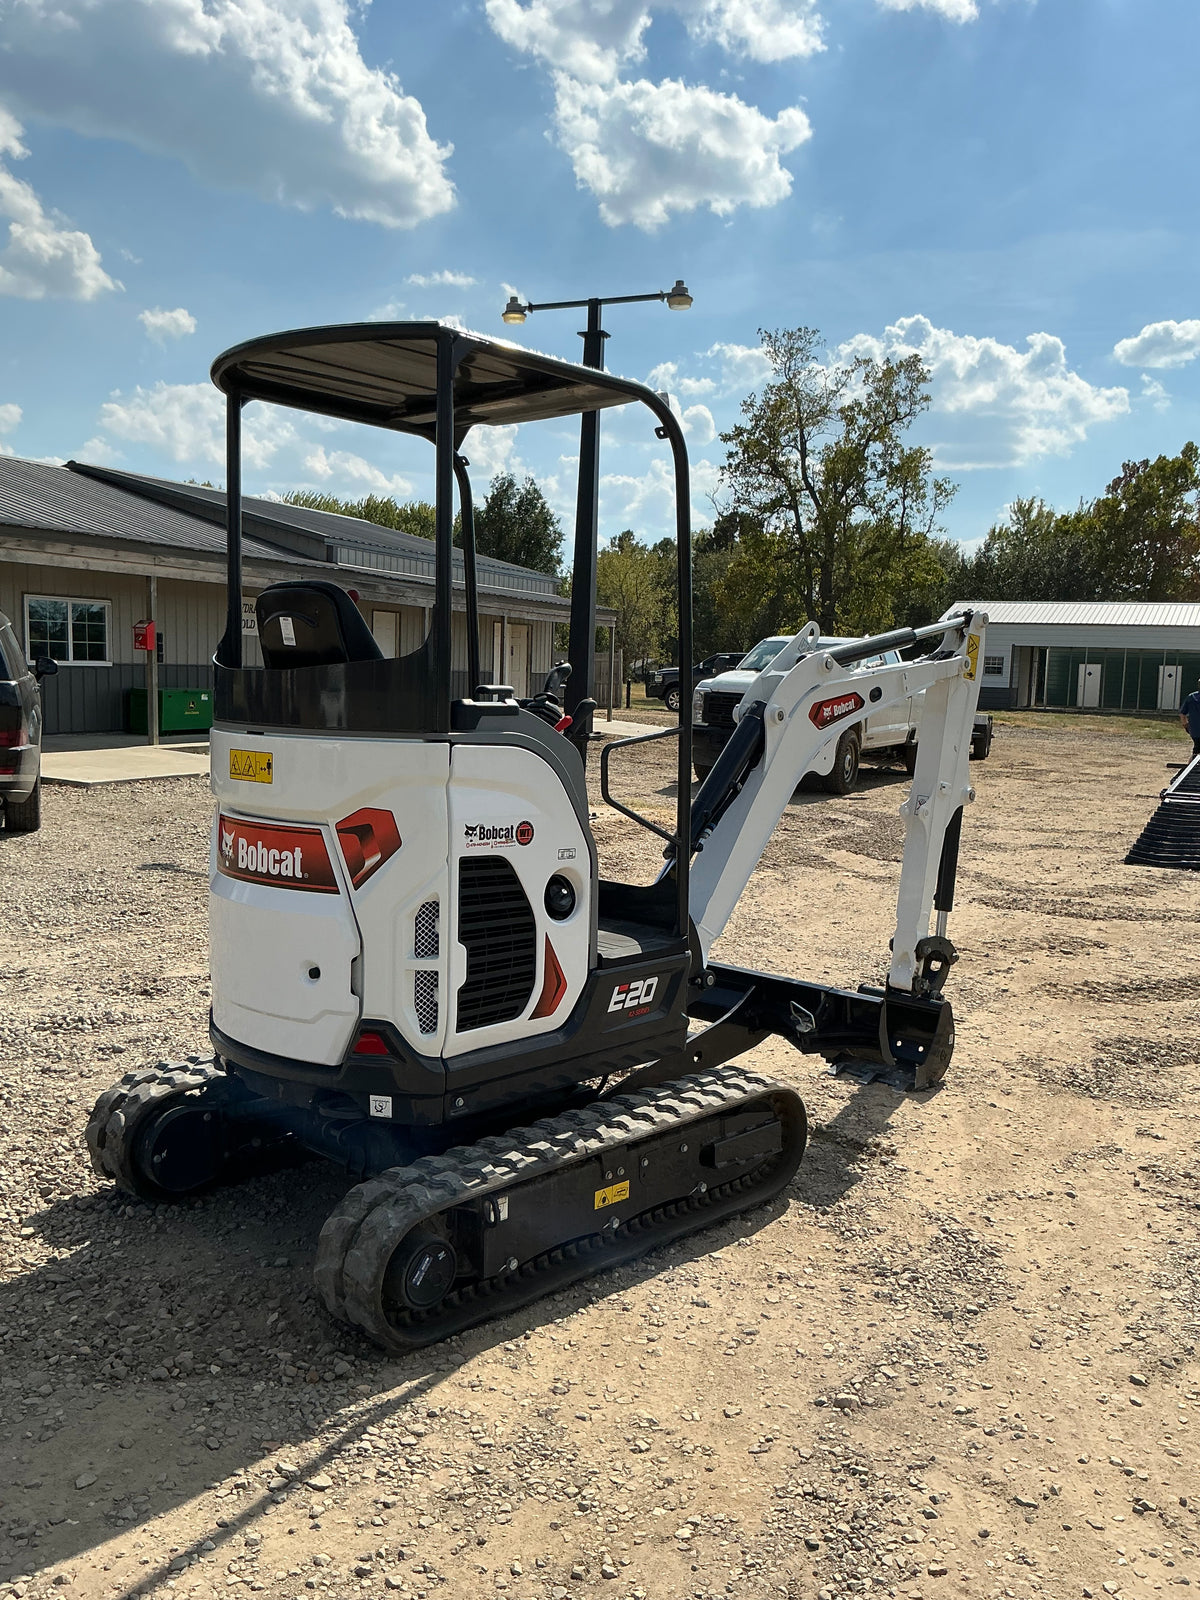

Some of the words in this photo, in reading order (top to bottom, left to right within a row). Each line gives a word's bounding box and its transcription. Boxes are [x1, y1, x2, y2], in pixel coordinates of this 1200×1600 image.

[833, 698, 855, 717] Bobcat
[478, 824, 514, 841] Bobcat
[238, 837, 303, 878] Bobcat
[607, 976, 659, 1013] E20
